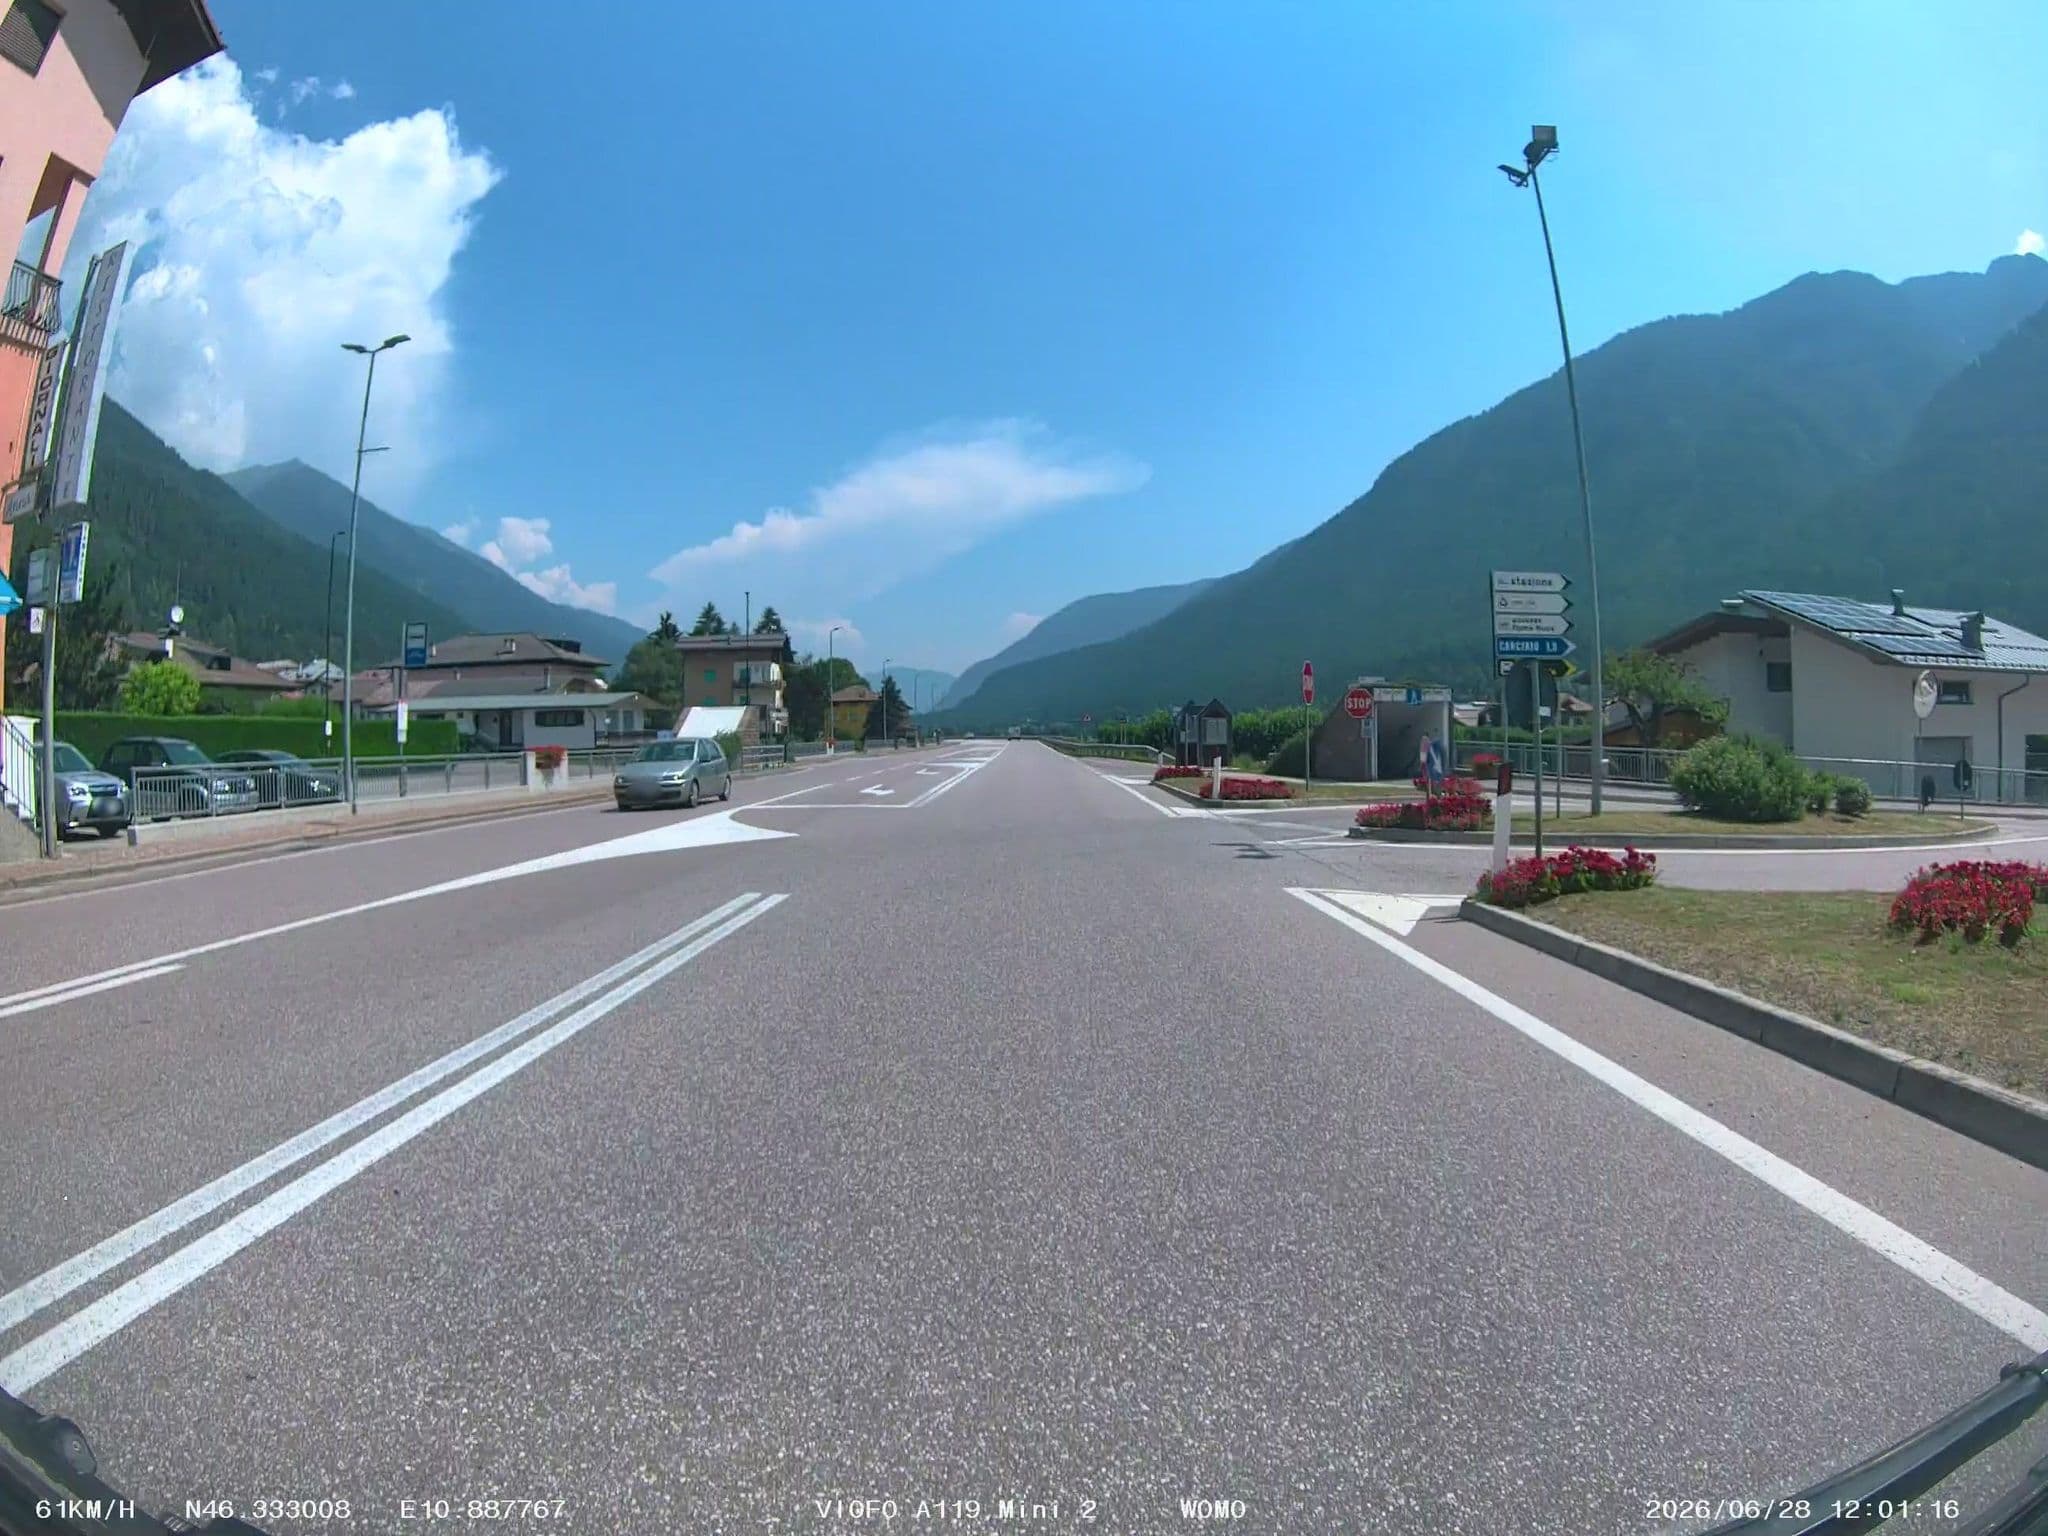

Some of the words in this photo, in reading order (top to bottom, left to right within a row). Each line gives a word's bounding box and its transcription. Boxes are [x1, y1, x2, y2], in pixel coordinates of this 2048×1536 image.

[30, 346, 58, 467] GIORNALI
[63, 252, 118, 499] RISTORANTE
[1347, 697, 1372, 710] STOP
